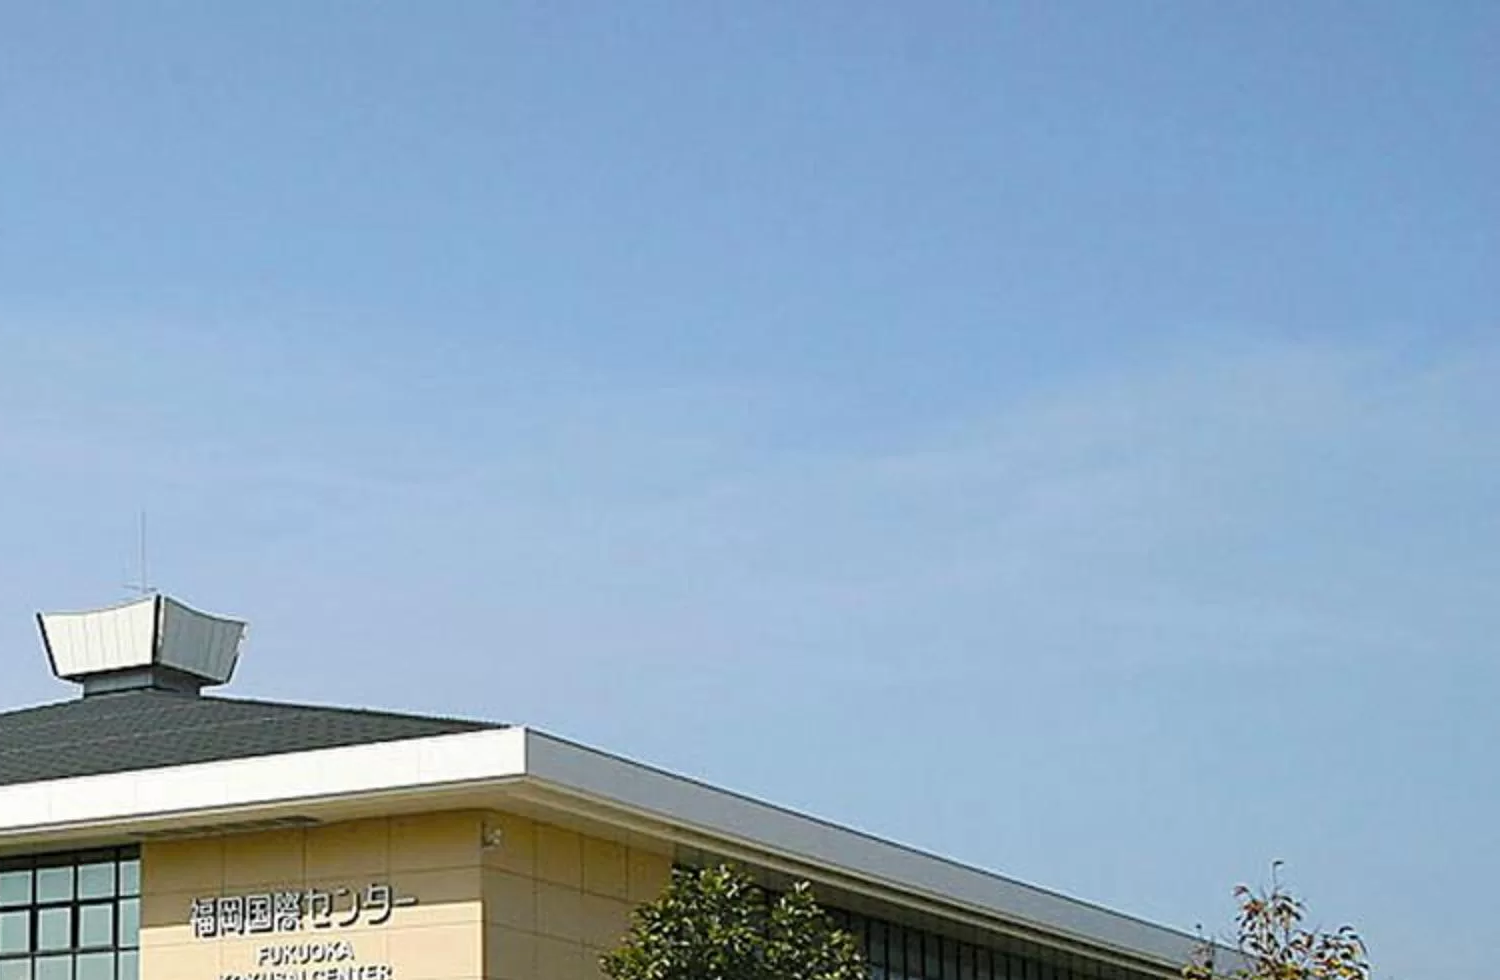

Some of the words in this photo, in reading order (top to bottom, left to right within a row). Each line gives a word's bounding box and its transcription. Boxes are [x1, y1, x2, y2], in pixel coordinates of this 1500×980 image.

[190, 885, 419, 938] 福岡国際センター
[258, 941, 355, 967] FUKUOKA
